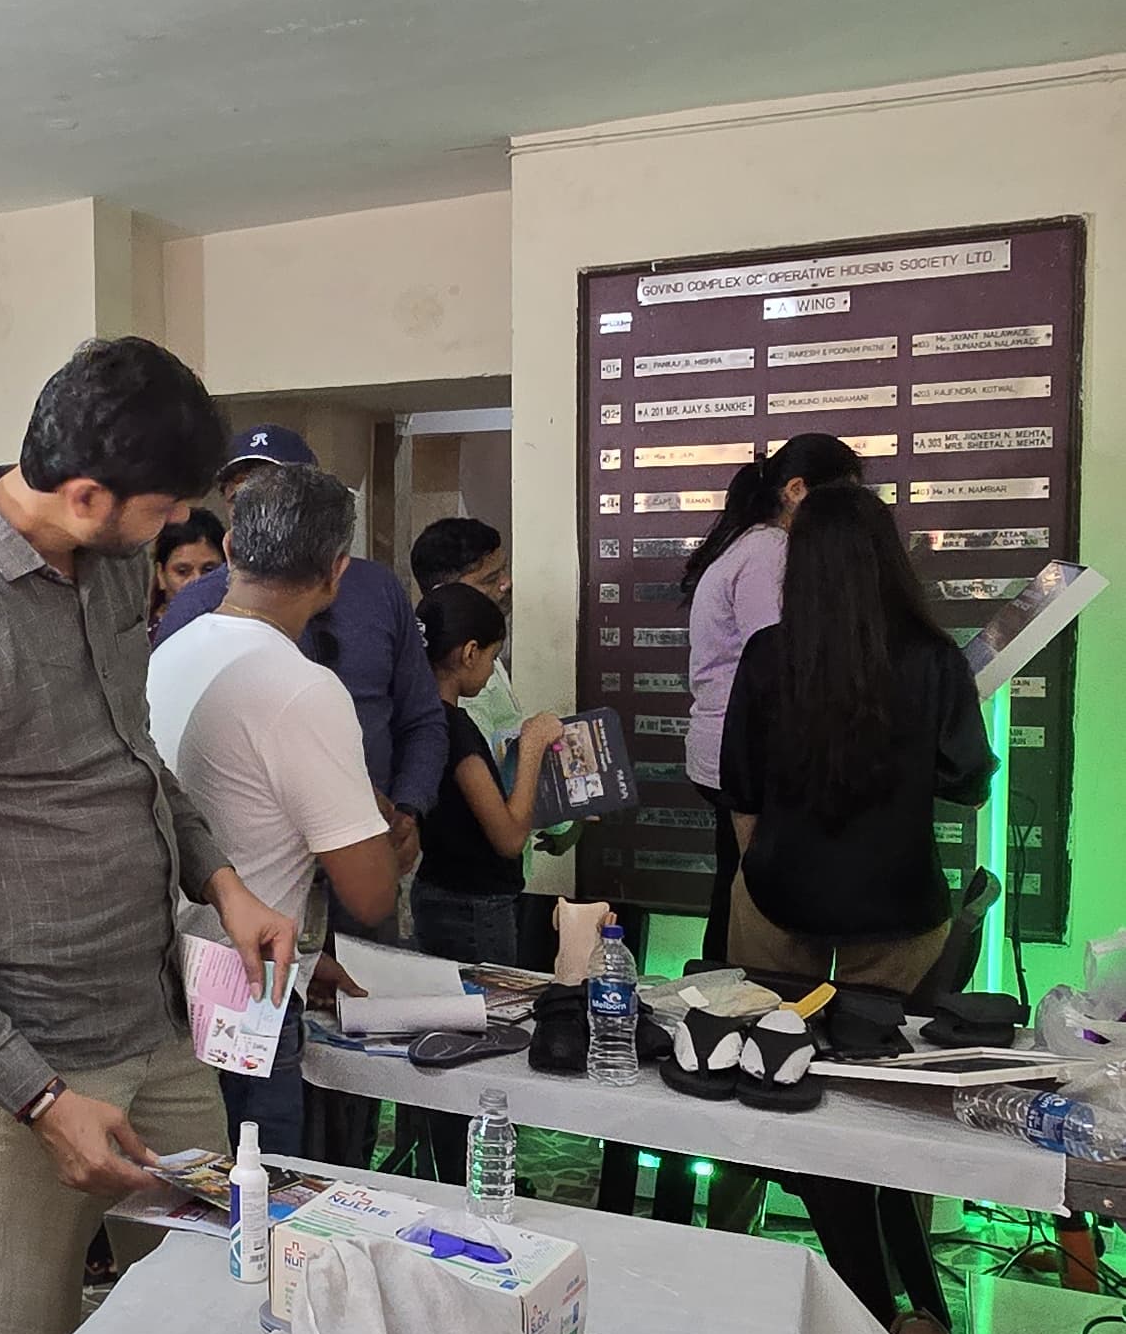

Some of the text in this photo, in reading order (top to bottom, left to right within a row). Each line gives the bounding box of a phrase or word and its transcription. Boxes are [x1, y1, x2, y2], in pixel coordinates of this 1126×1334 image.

[642, 282, 684, 298] GOVIND
[687, 277, 741, 293] COMPLEX
[840, 262, 893, 277] HOUSING
[900, 254, 959, 271] SOCIETY
[797, 297, 836, 312] WING
[949, 331, 980, 342] JAYANT
[604, 410, 617, 419] 02
[643, 401, 747, 418] A 201 MR. AJAY S. SANKHE
[919, 438, 927, 449] A
[944, 433, 959, 442] MR.
[963, 430, 1002, 441] JIGNESH
[1016, 428, 1046, 439] MEHTA
[944, 441, 964, 450] MRS.
[967, 438, 1004, 449] SHEETAL
[1016, 436, 1046, 447] MEHTA
[592, 999, 626, 1011] Melborn
